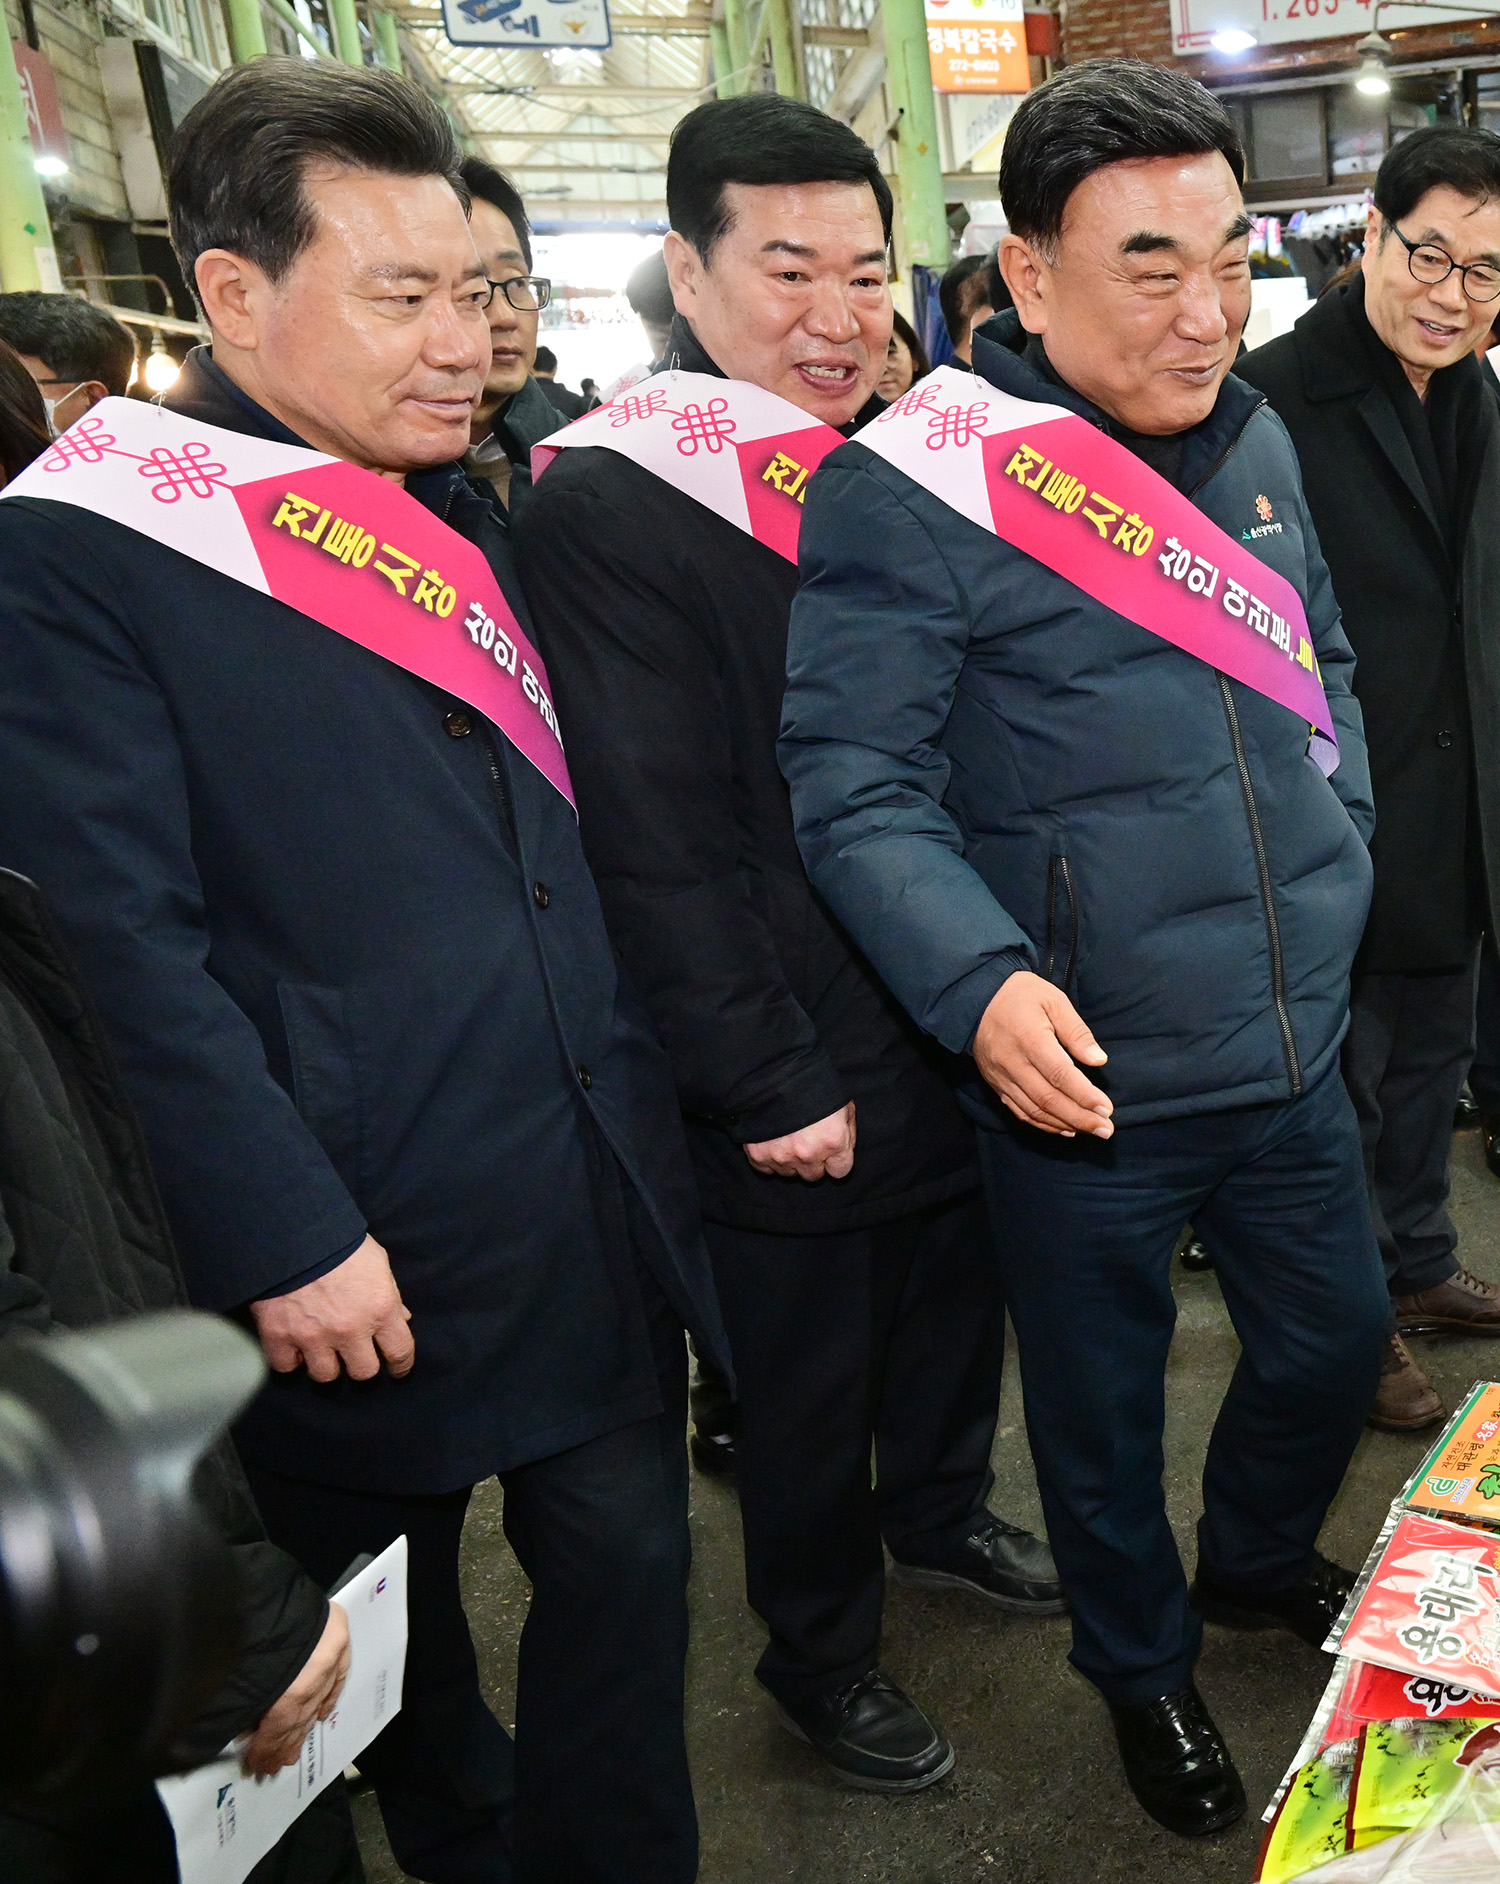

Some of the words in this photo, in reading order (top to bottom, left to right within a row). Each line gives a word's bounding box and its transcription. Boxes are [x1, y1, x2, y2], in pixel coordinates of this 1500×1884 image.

[927, 27, 1017, 54] 경북칼국수
[271, 491, 457, 619] 전통시장
[463, 601, 518, 677] 상인
[1004, 442, 1154, 557] 전통시장
[1157, 535, 1220, 600] 상인
[1223, 577, 1297, 662] 여러분,
[1442, 1440, 1467, 1468] 자연건조
[1456, 1441, 1485, 1472] 대관령
[1397, 1552, 1498, 1665] 용대리
